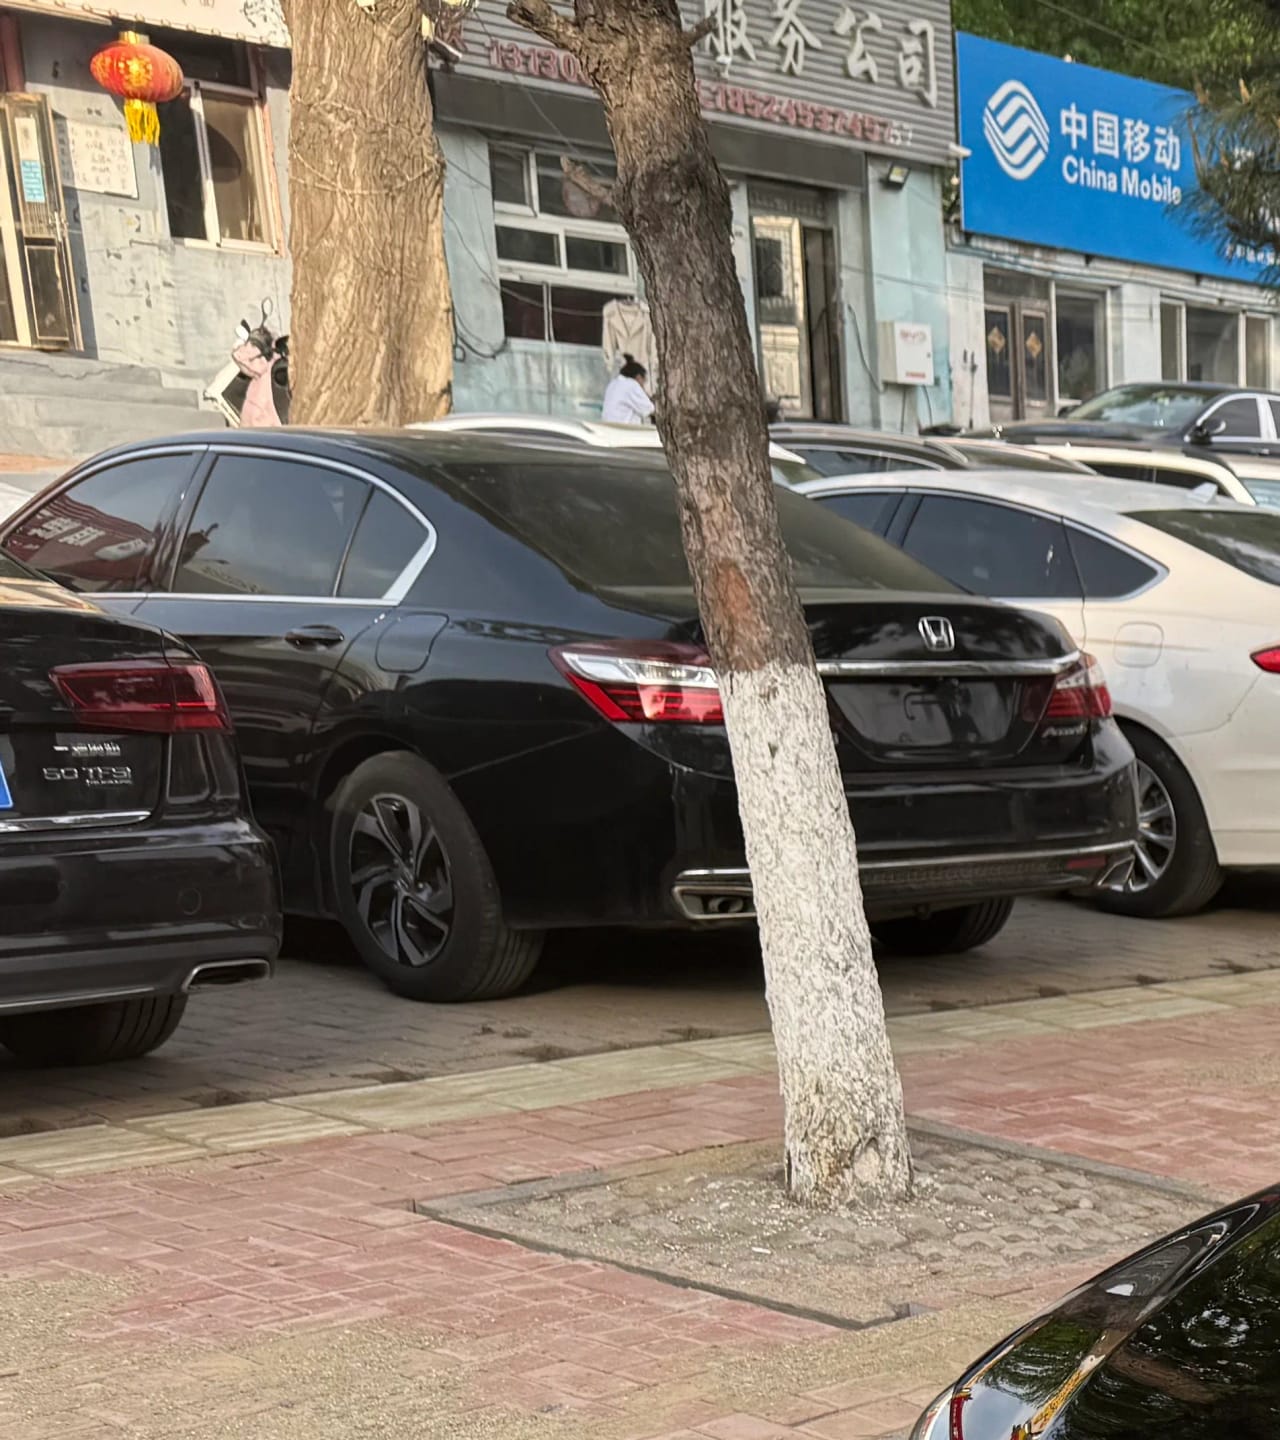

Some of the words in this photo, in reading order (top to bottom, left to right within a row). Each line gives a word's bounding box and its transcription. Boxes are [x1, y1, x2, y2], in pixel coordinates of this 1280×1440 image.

[1060, 102, 1182, 171] 中国移动
[1061, 155, 1117, 193] China
[1121, 166, 1183, 206] Mobile
